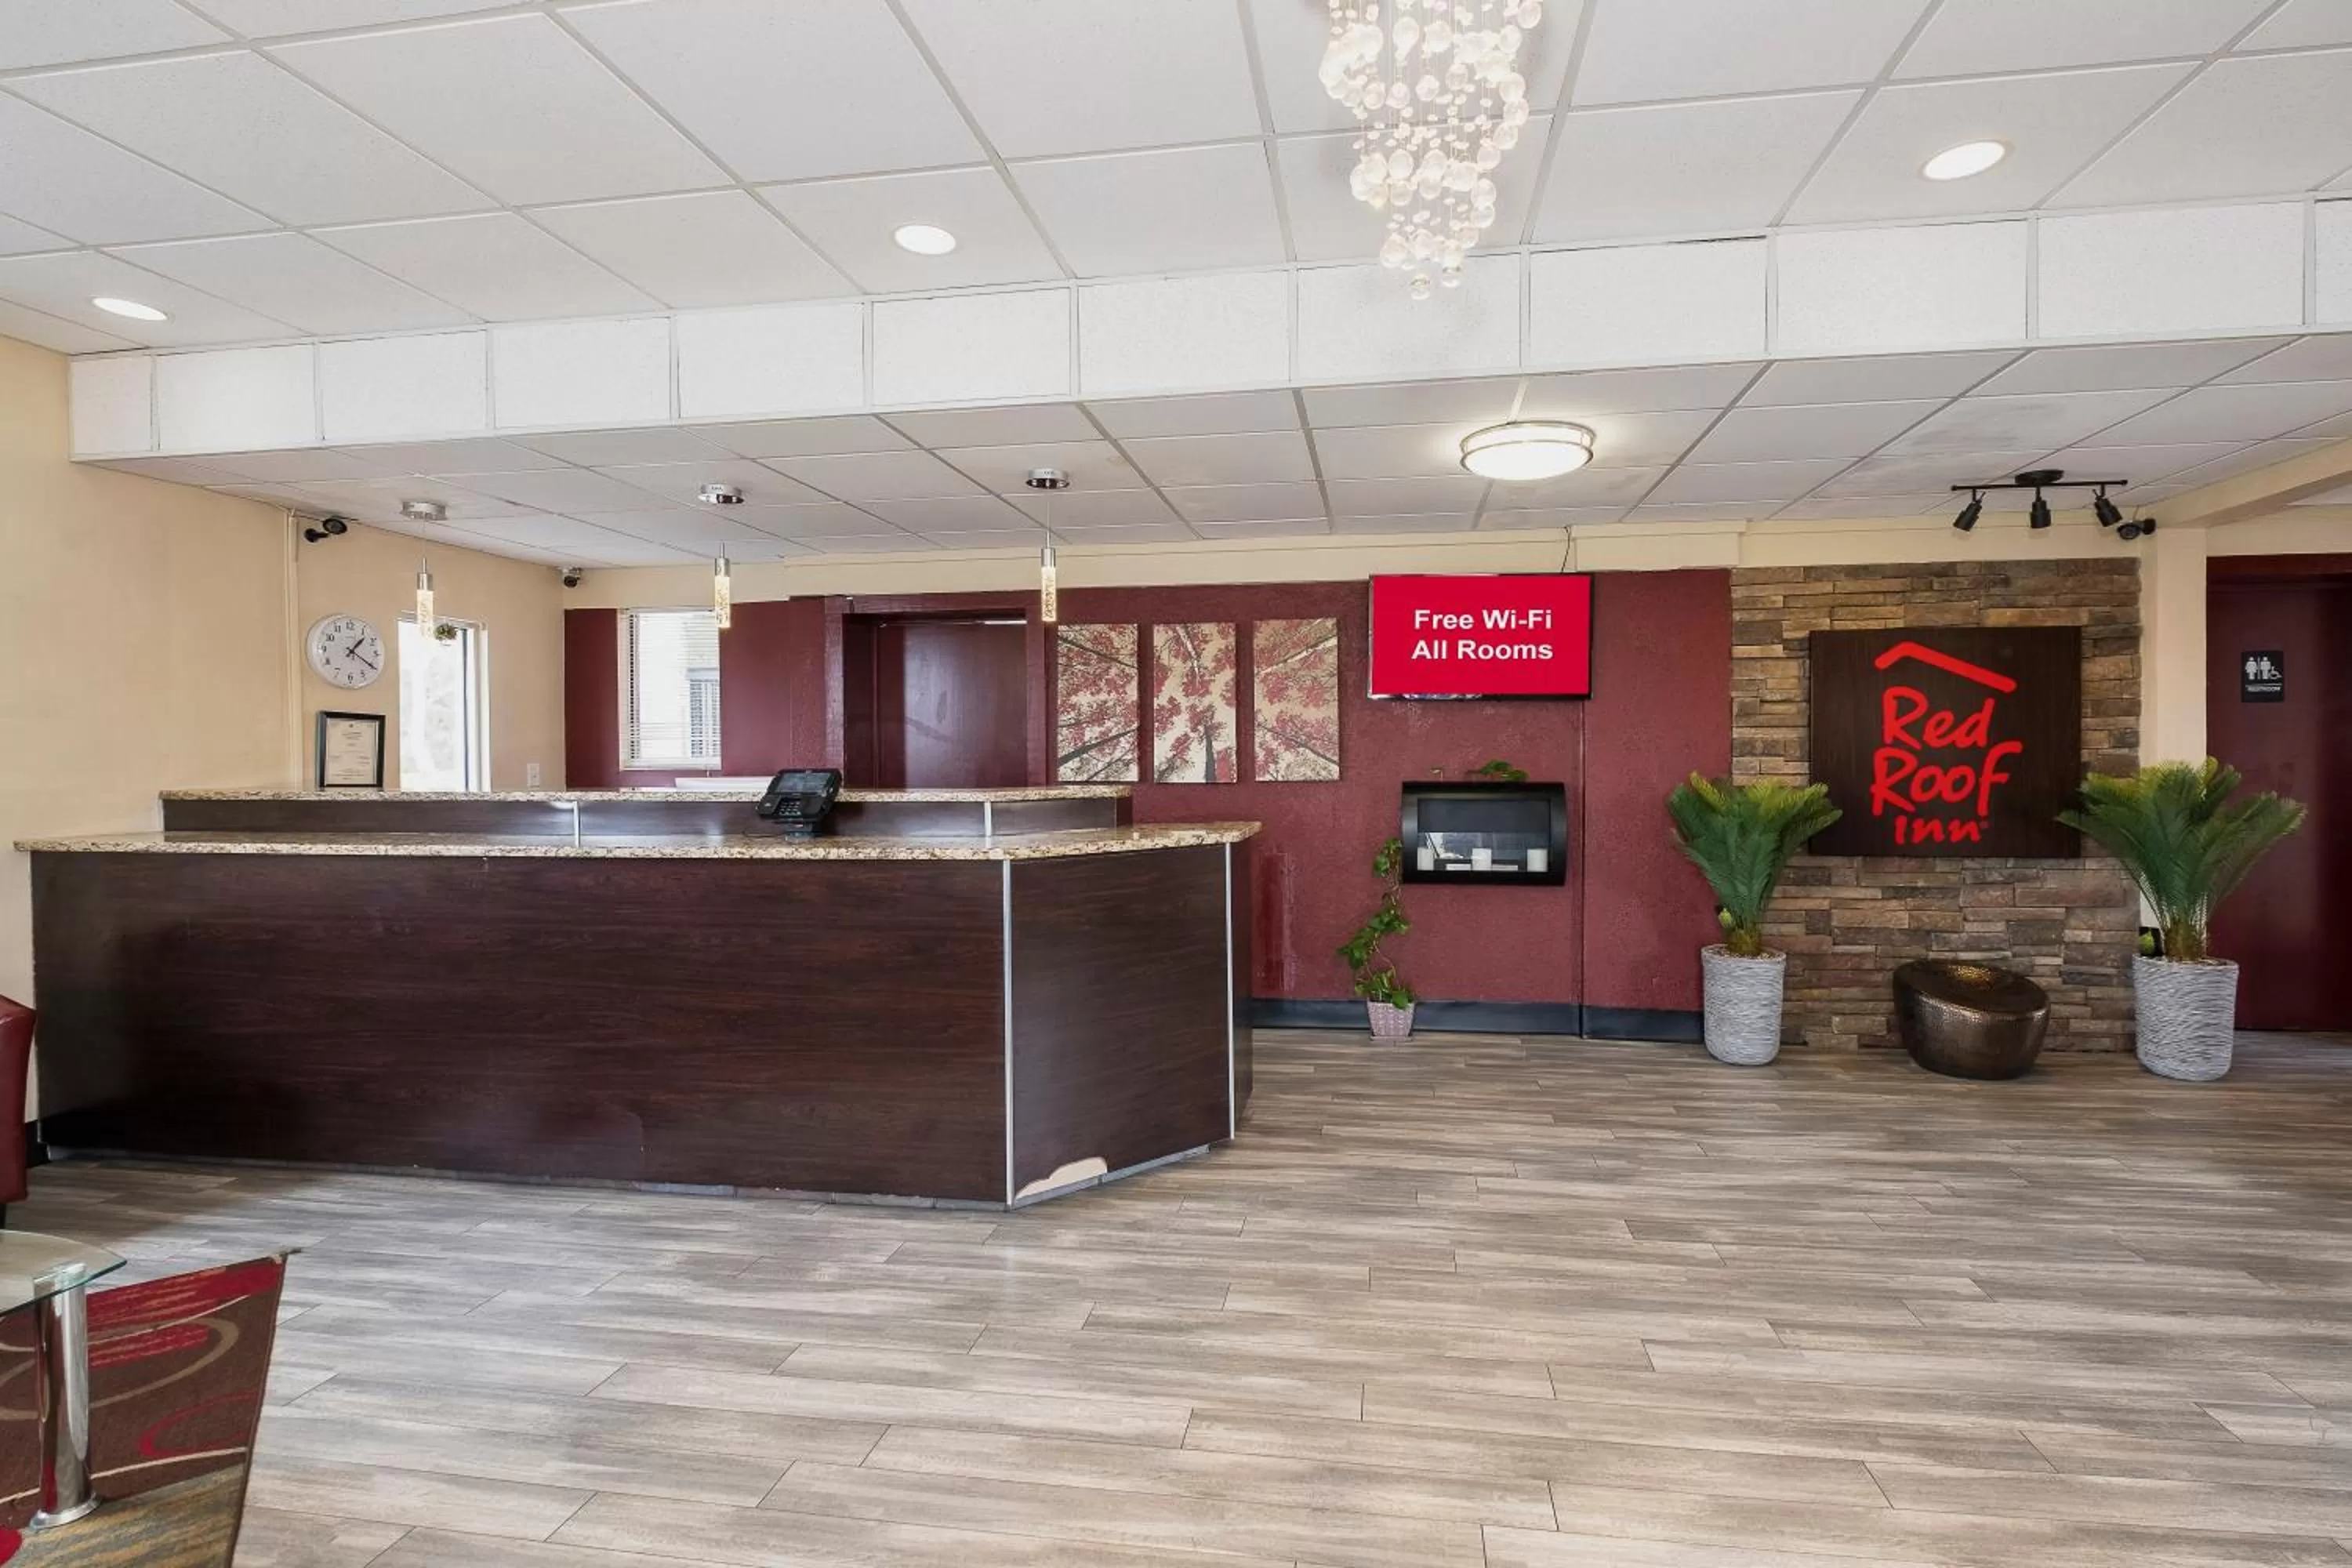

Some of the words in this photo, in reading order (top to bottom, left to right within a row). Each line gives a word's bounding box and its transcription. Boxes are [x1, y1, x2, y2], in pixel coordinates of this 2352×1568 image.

[1414, 609, 1474, 630] Free
[1483, 609, 1552, 630] Wi-Fi
[1411, 639, 1447, 659] All
[1457, 639, 1553, 659] Rooms
[1883, 686, 1996, 750] Red
[1870, 741, 2024, 817] Roof
